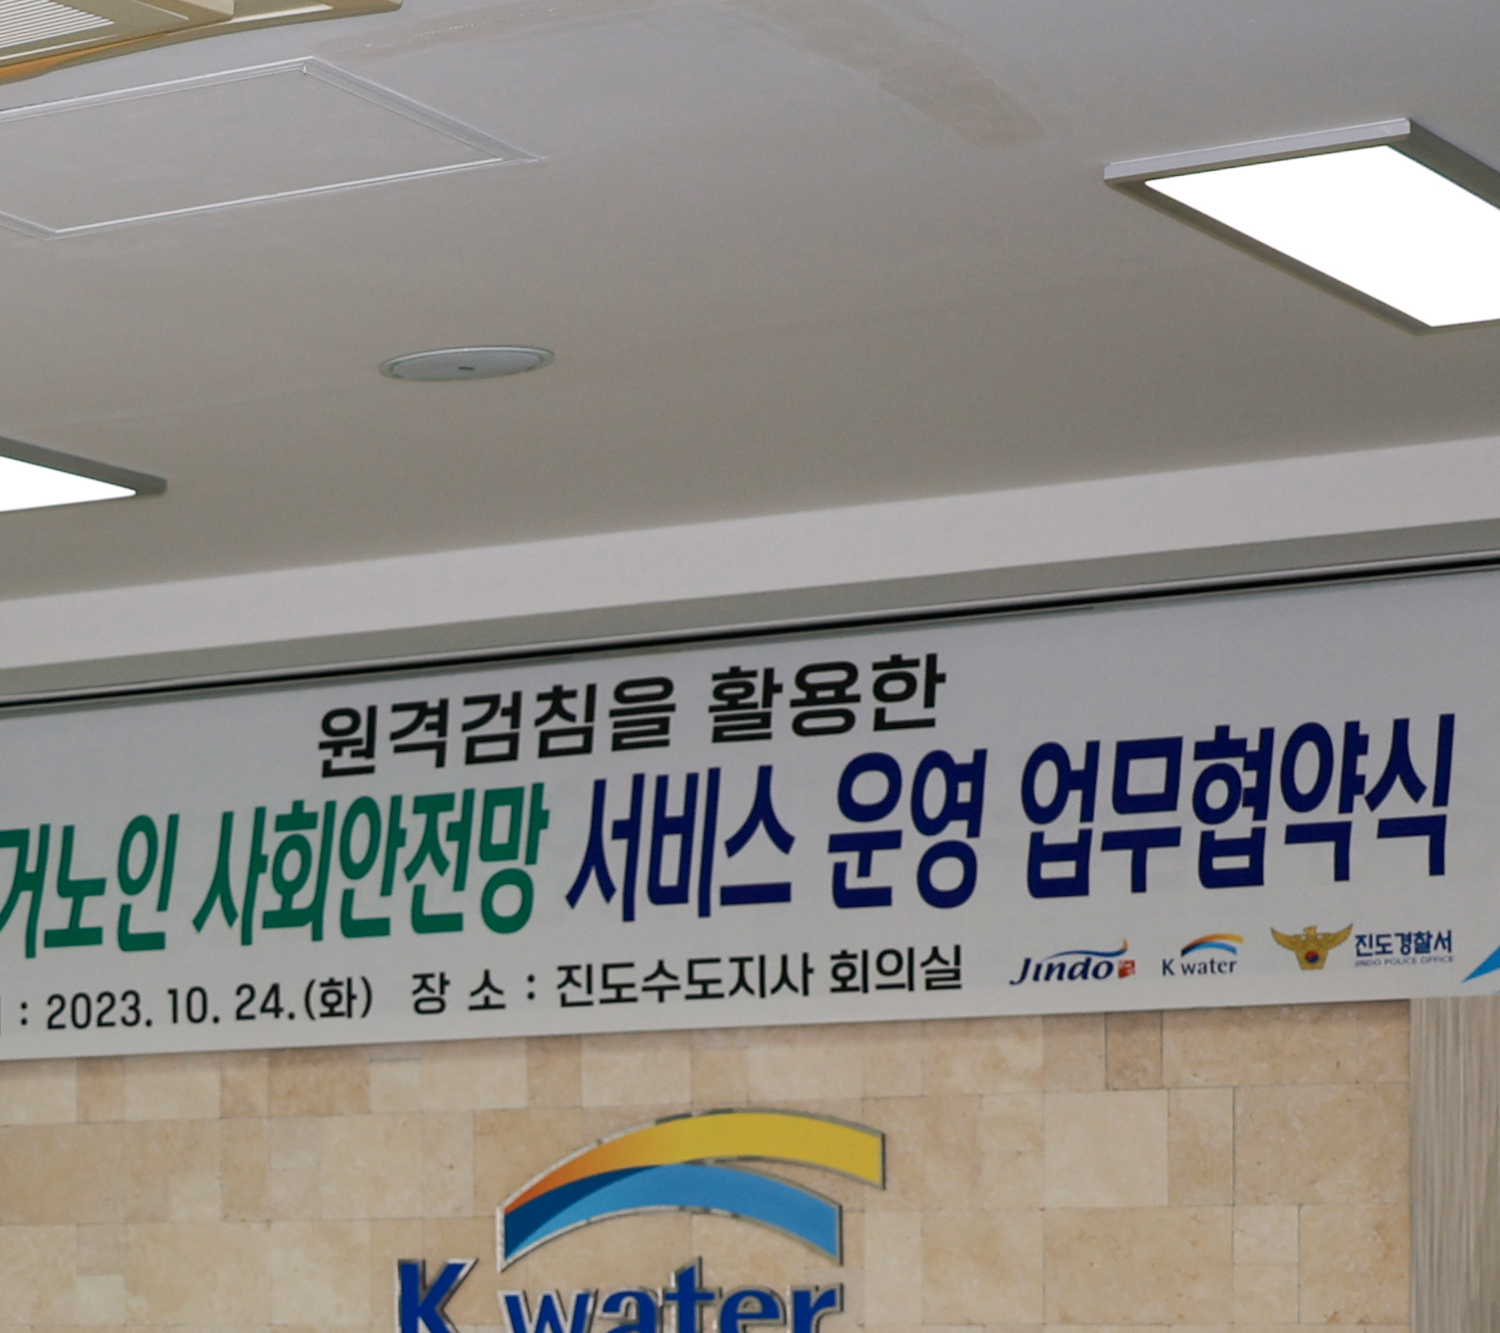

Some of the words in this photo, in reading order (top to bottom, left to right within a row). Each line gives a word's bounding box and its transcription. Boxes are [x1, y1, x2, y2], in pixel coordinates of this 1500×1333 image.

[317, 675, 678, 778] 원격검침을
[707, 652, 948, 744] 활용한
[192, 781, 550, 946] 사회안전망
[565, 764, 796, 923] 서비스
[827, 748, 988, 909] 운영
[1020, 713, 1457, 899] 업무협약식
[1009, 955, 1114, 985] Jindo
[1355, 929, 1452, 957] 진도경찰서
[46, 989, 153, 1030] 2023.
[167, 986, 221, 1024] 10.
[557, 953, 814, 1008] 진도수도지사
[829, 944, 963, 994] 회의실
